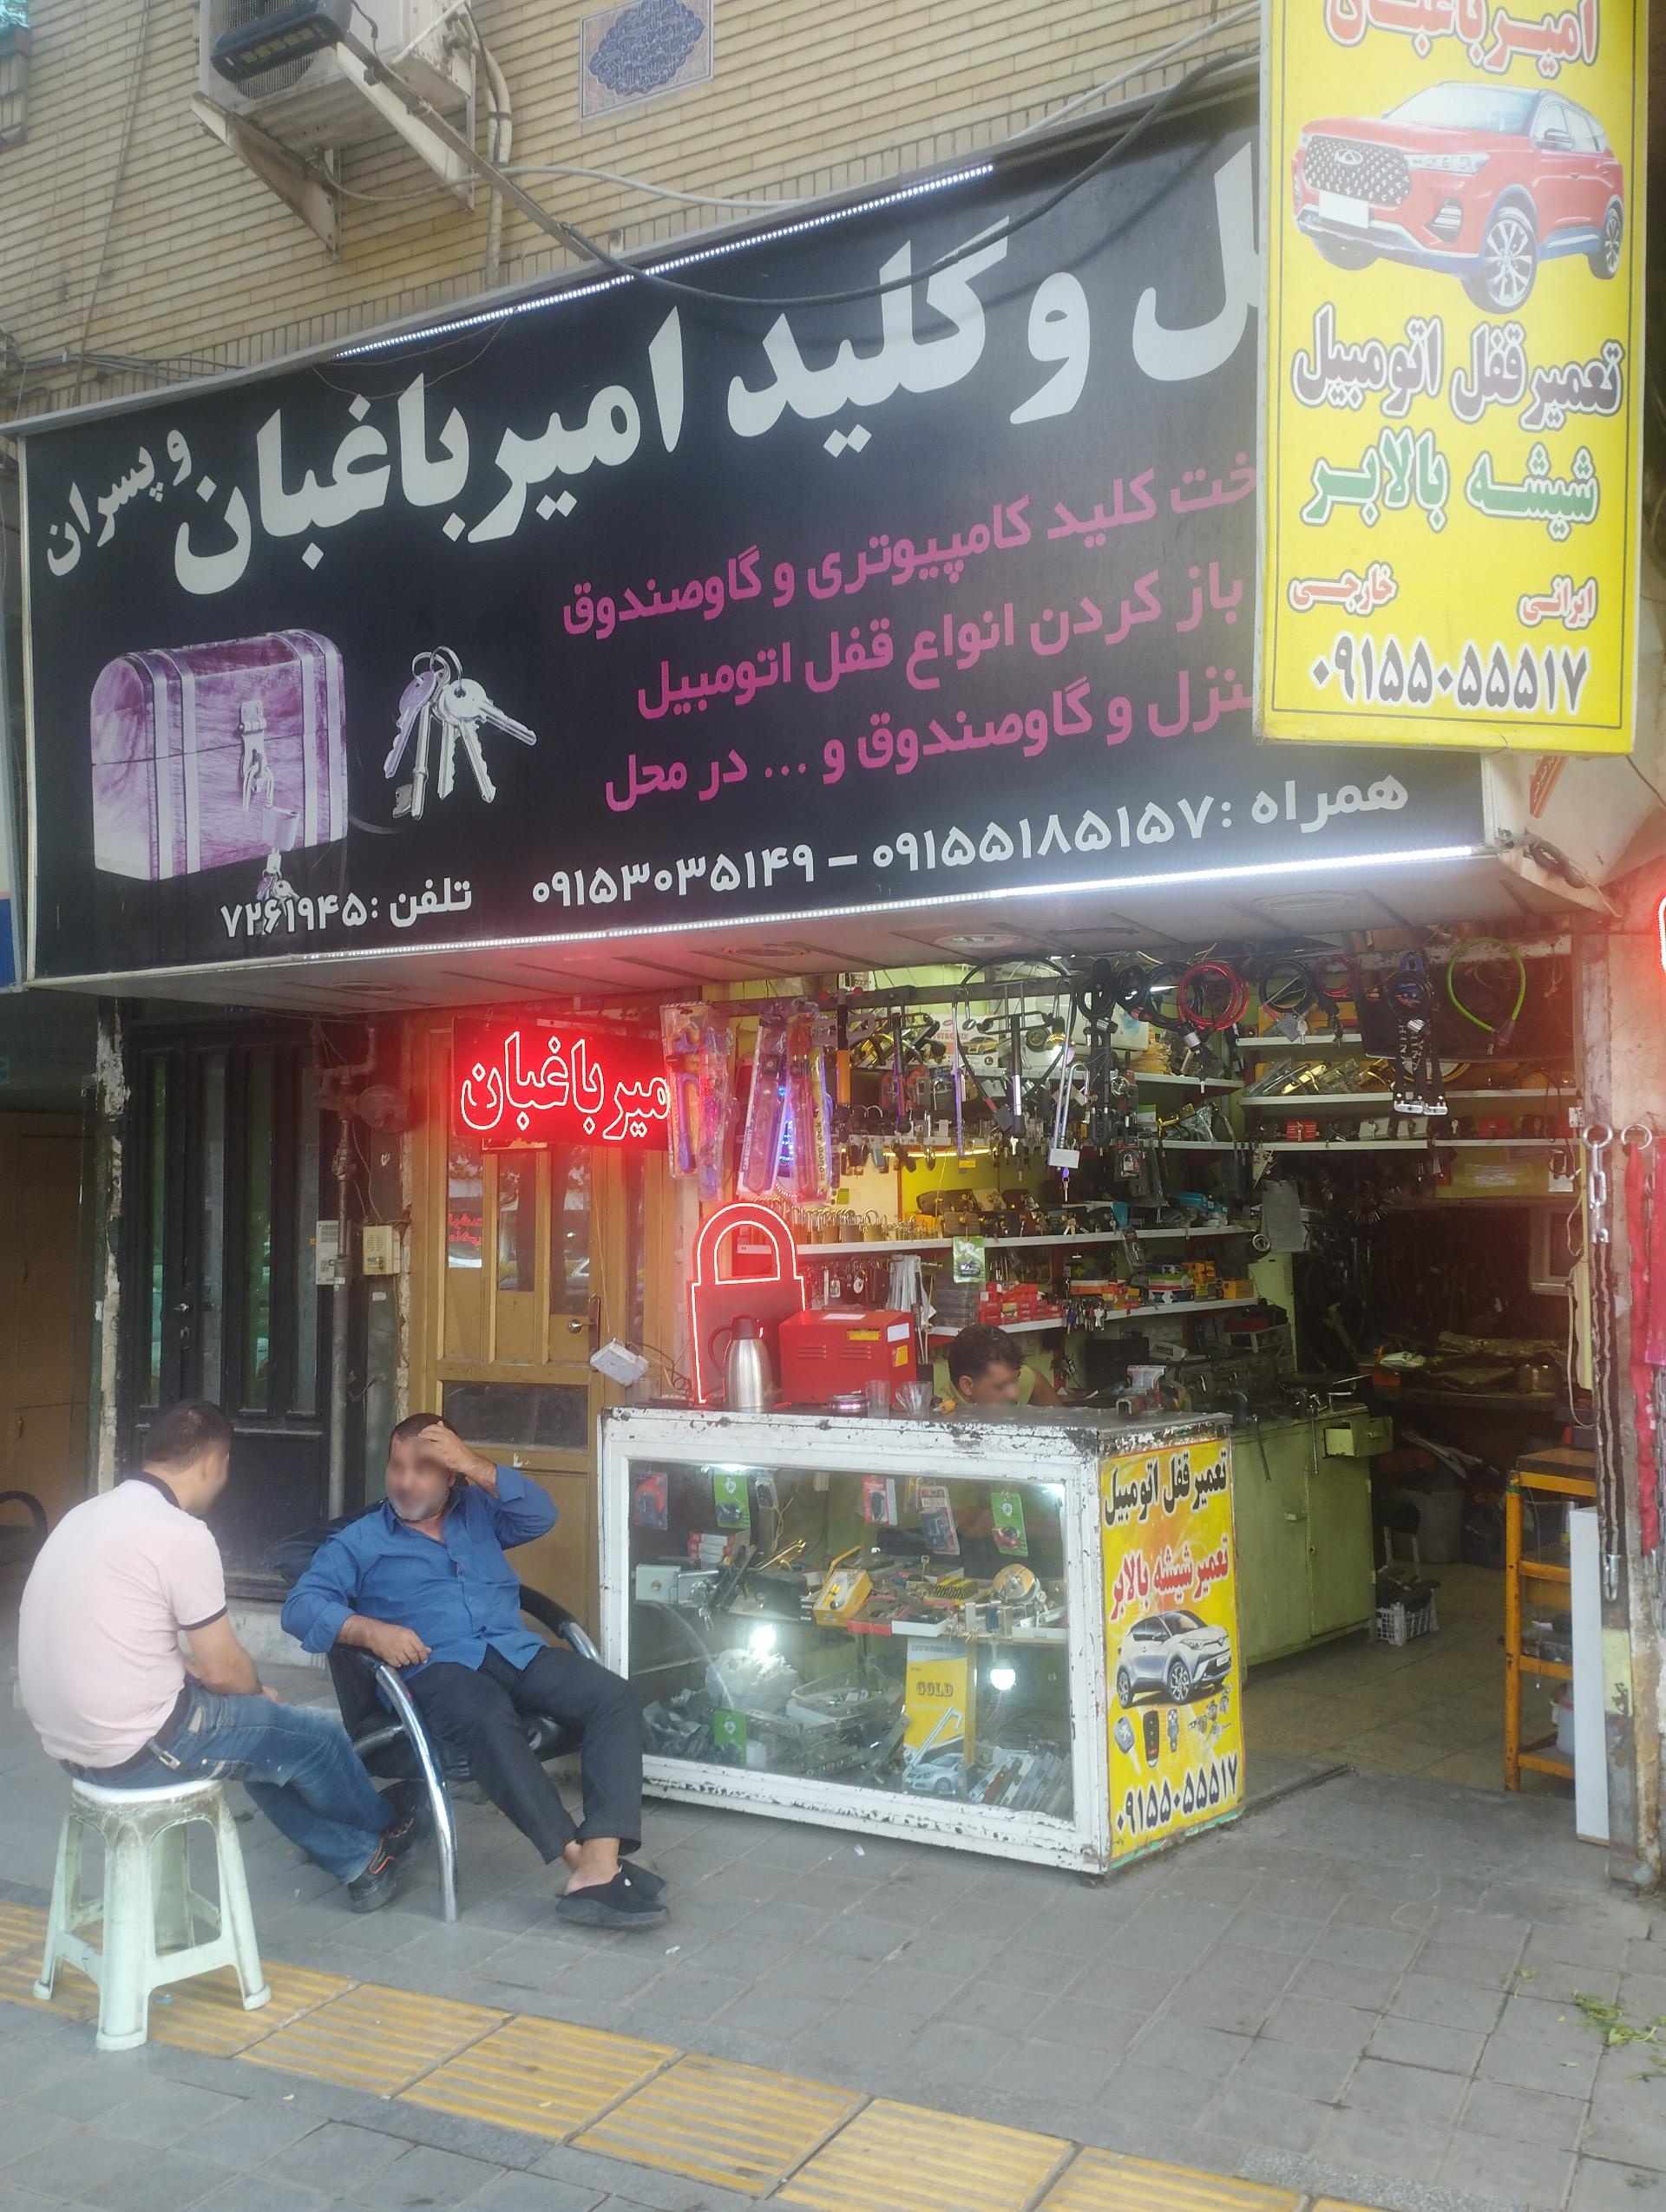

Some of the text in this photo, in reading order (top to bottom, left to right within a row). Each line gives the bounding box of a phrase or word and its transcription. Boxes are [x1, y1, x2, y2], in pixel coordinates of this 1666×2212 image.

[728, 215, 1009, 457] کلید
[1010, 272, 1090, 425] و
[1291, 302, 1625, 432] تعمیر قفل اتومبیل
[468, 306, 684, 543] امیر
[47, 429, 191, 577] و پسران
[175, 373, 470, 595] باغبان
[1047, 468, 1157, 548] کلید
[1301, 426, 1599, 541] شیشه بالابر
[773, 561, 796, 607] و
[807, 494, 1032, 599] کامپیوتری
[1288, 560, 1399, 615] خارجی
[563, 544, 762, 640] گاوصندوق
[1517, 575, 1597, 630] ایرانی
[638, 561, 1243, 719] باز کردن انواع قفل اتومبیل
[1310, 632, 1591, 716] ۰۹۱۵۵۰۵۵۵۱۷
[823, 738, 845, 785] و
[857, 675, 1093, 776] گاوصندوق
[1106, 697, 1132, 746] و
[606, 753, 688, 812] محل
[699, 749, 748, 801] در
[461, 1031, 604, 1135] باغبان
[1105, 1451, 1227, 1526] تعمیر قفل اتومبیل
[1111, 1535, 1229, 1620] تعمیر شیشه بالابر
[916, 1680, 954, 1698] GOLD
